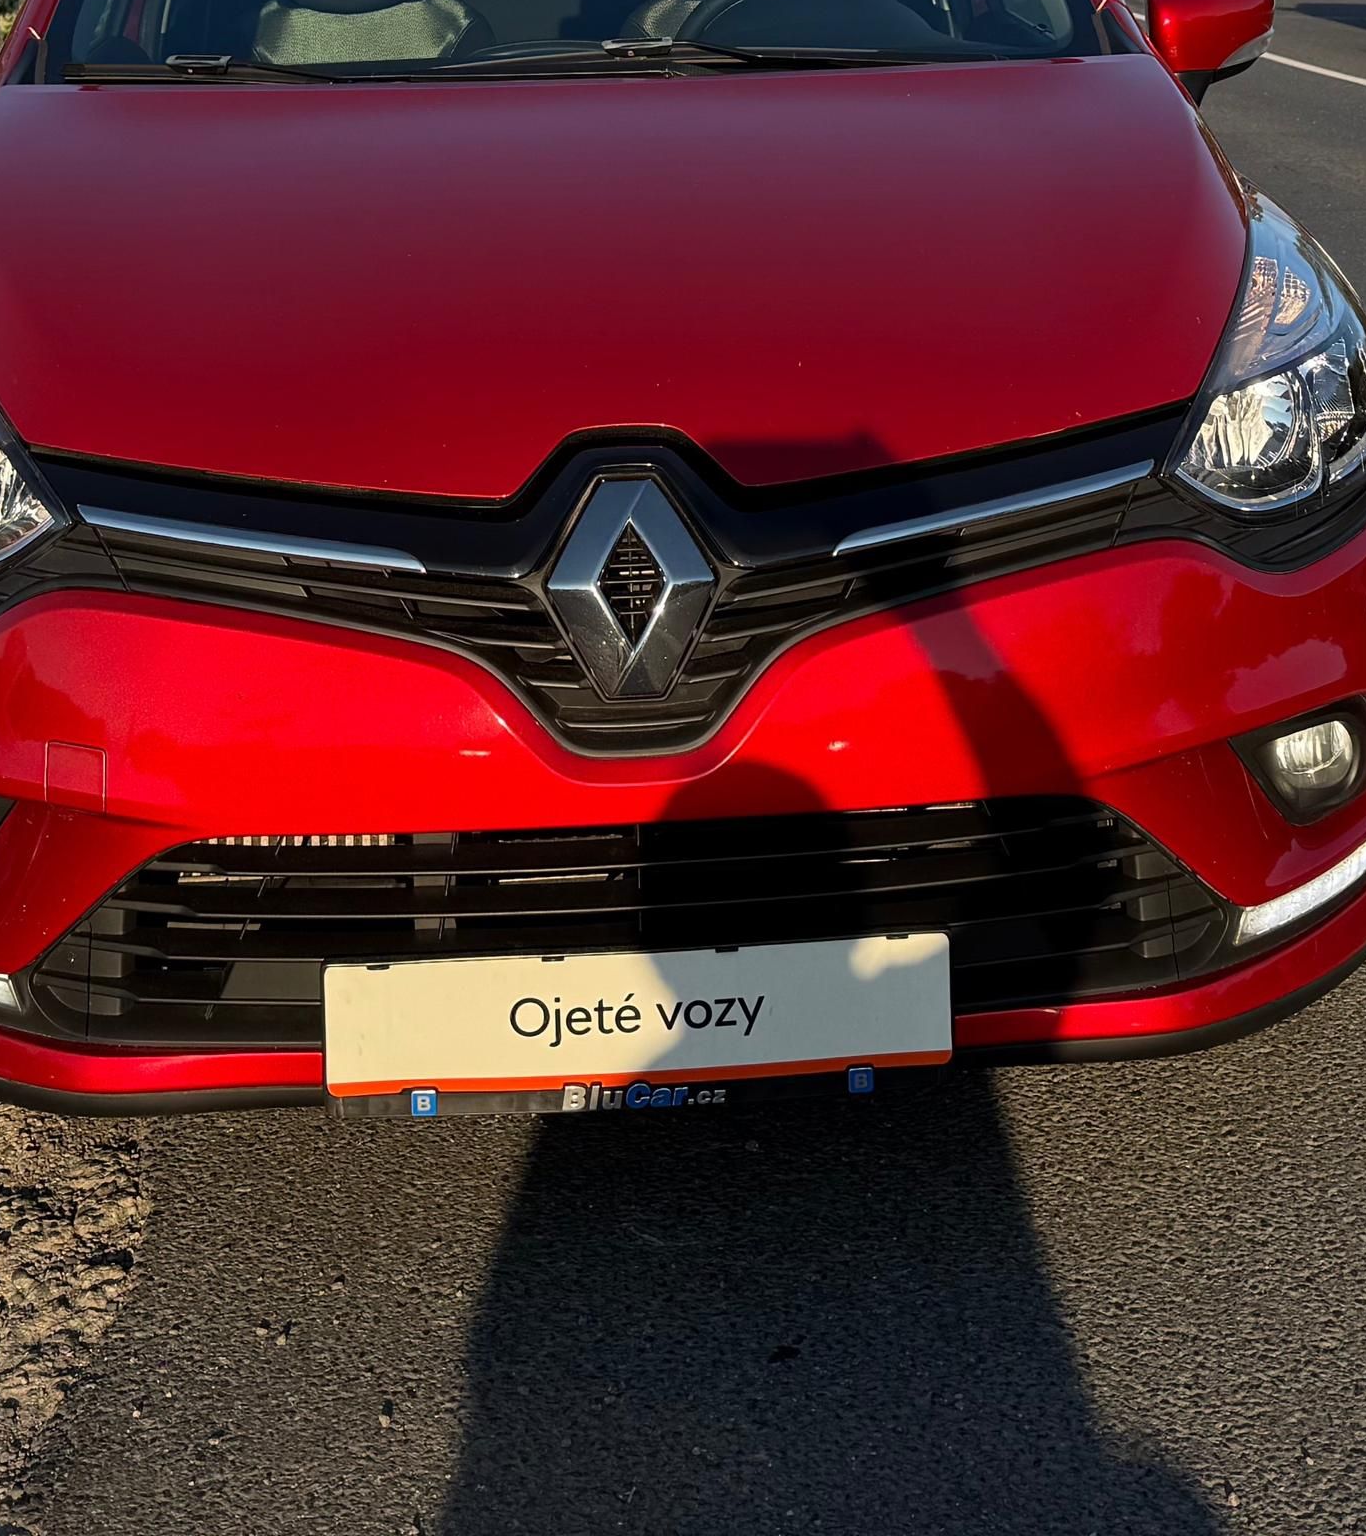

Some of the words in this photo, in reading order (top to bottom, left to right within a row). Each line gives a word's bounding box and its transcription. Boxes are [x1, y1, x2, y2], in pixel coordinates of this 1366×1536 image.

[509, 992, 642, 1048] Ojeté
[655, 995, 765, 1036] vozy
[855, 1073, 868, 1088] B
[417, 1096, 431, 1112] B
[561, 1082, 727, 1112] BluCar.cz
